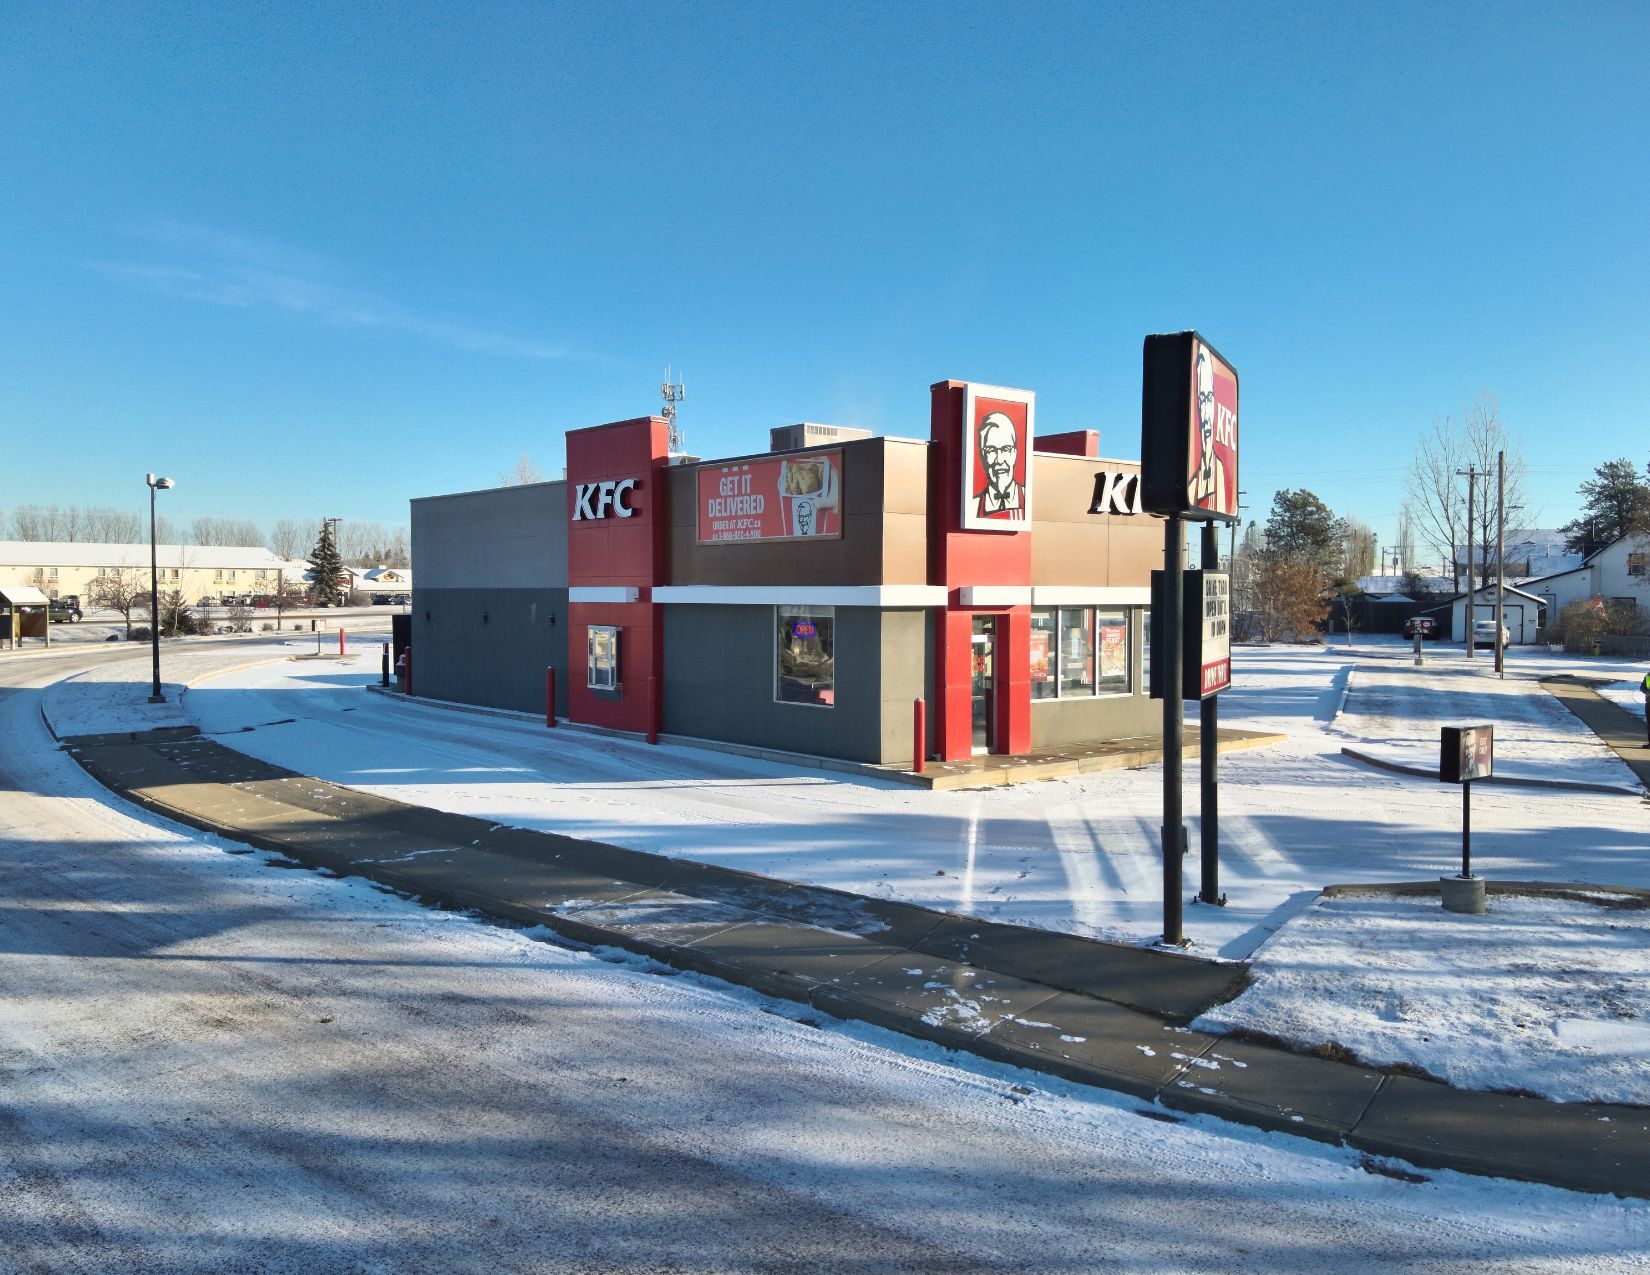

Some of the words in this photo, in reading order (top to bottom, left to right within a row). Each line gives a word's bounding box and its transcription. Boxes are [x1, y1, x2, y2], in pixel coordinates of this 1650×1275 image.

[1215, 402, 1237, 452] KFC
[720, 476, 739, 496] GET
[741, 474, 752, 495] IT
[572, 478, 638, 520] KFC
[709, 495, 765, 517] DELIVERED
[712, 520, 729, 530] ORDER
[729, 519, 737, 529] AT
[736, 518, 761, 529] KFC.ca
[796, 624, 814, 635] OPEN
